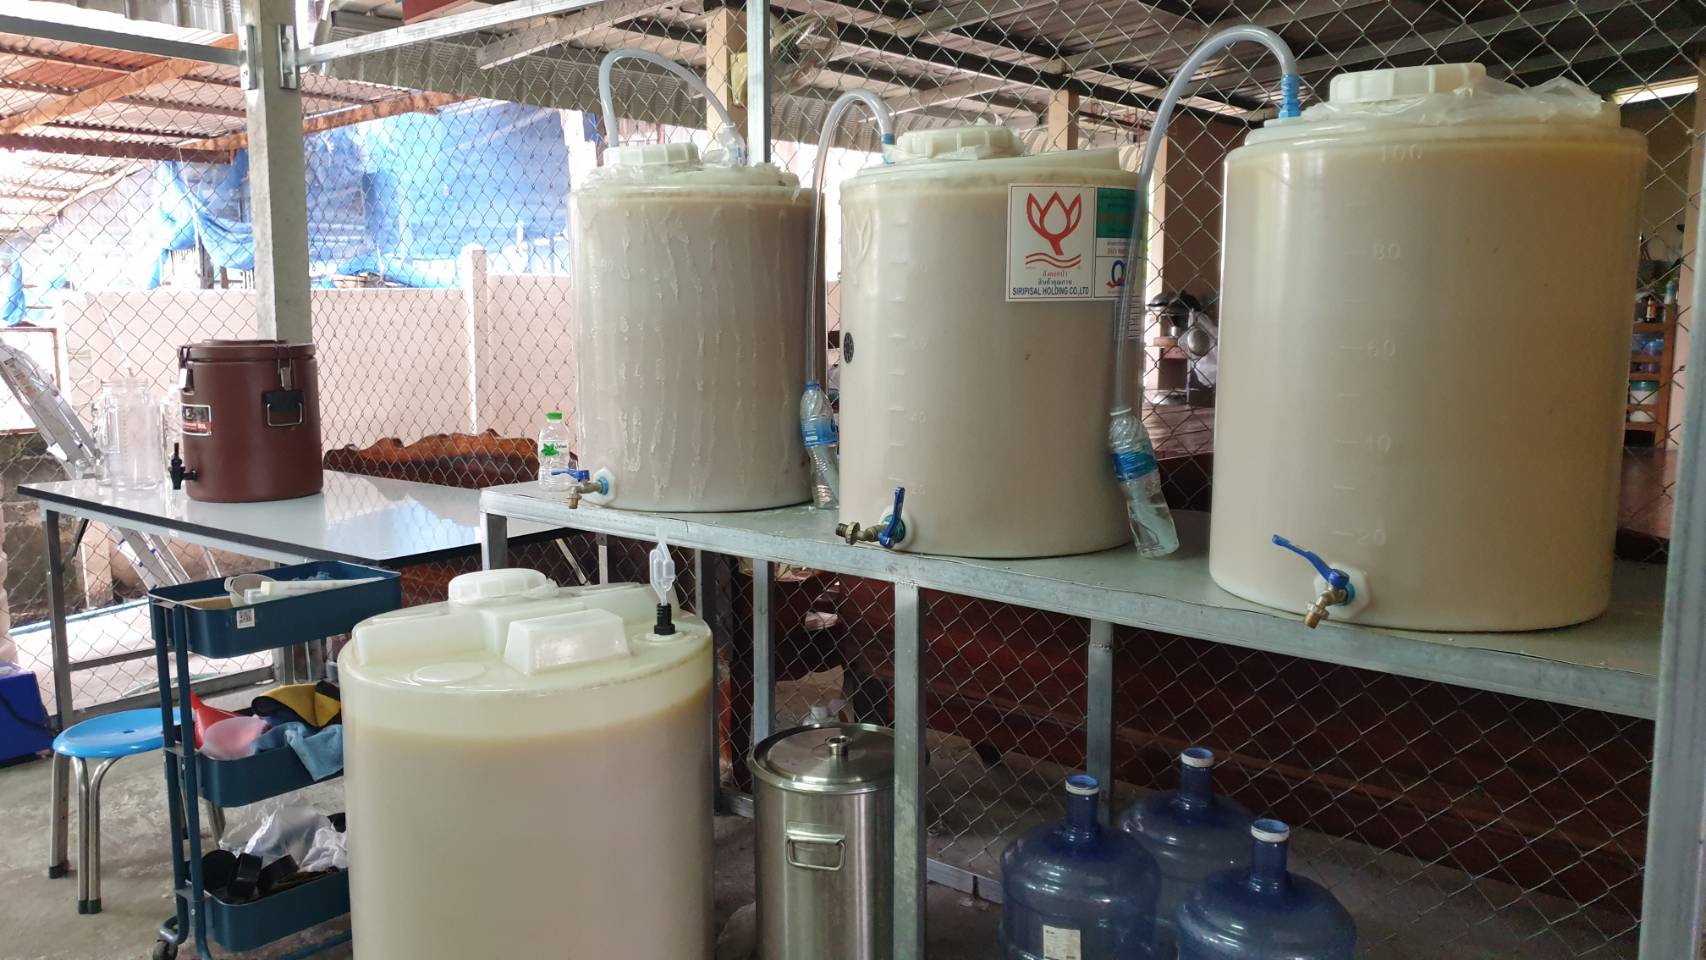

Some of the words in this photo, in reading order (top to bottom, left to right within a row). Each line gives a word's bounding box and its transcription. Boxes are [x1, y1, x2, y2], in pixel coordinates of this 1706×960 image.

[1381, 144, 1424, 161] 100
[1012, 287, 1041, 296] SIRIPISAL
[1043, 287, 1068, 296] HOLDING
